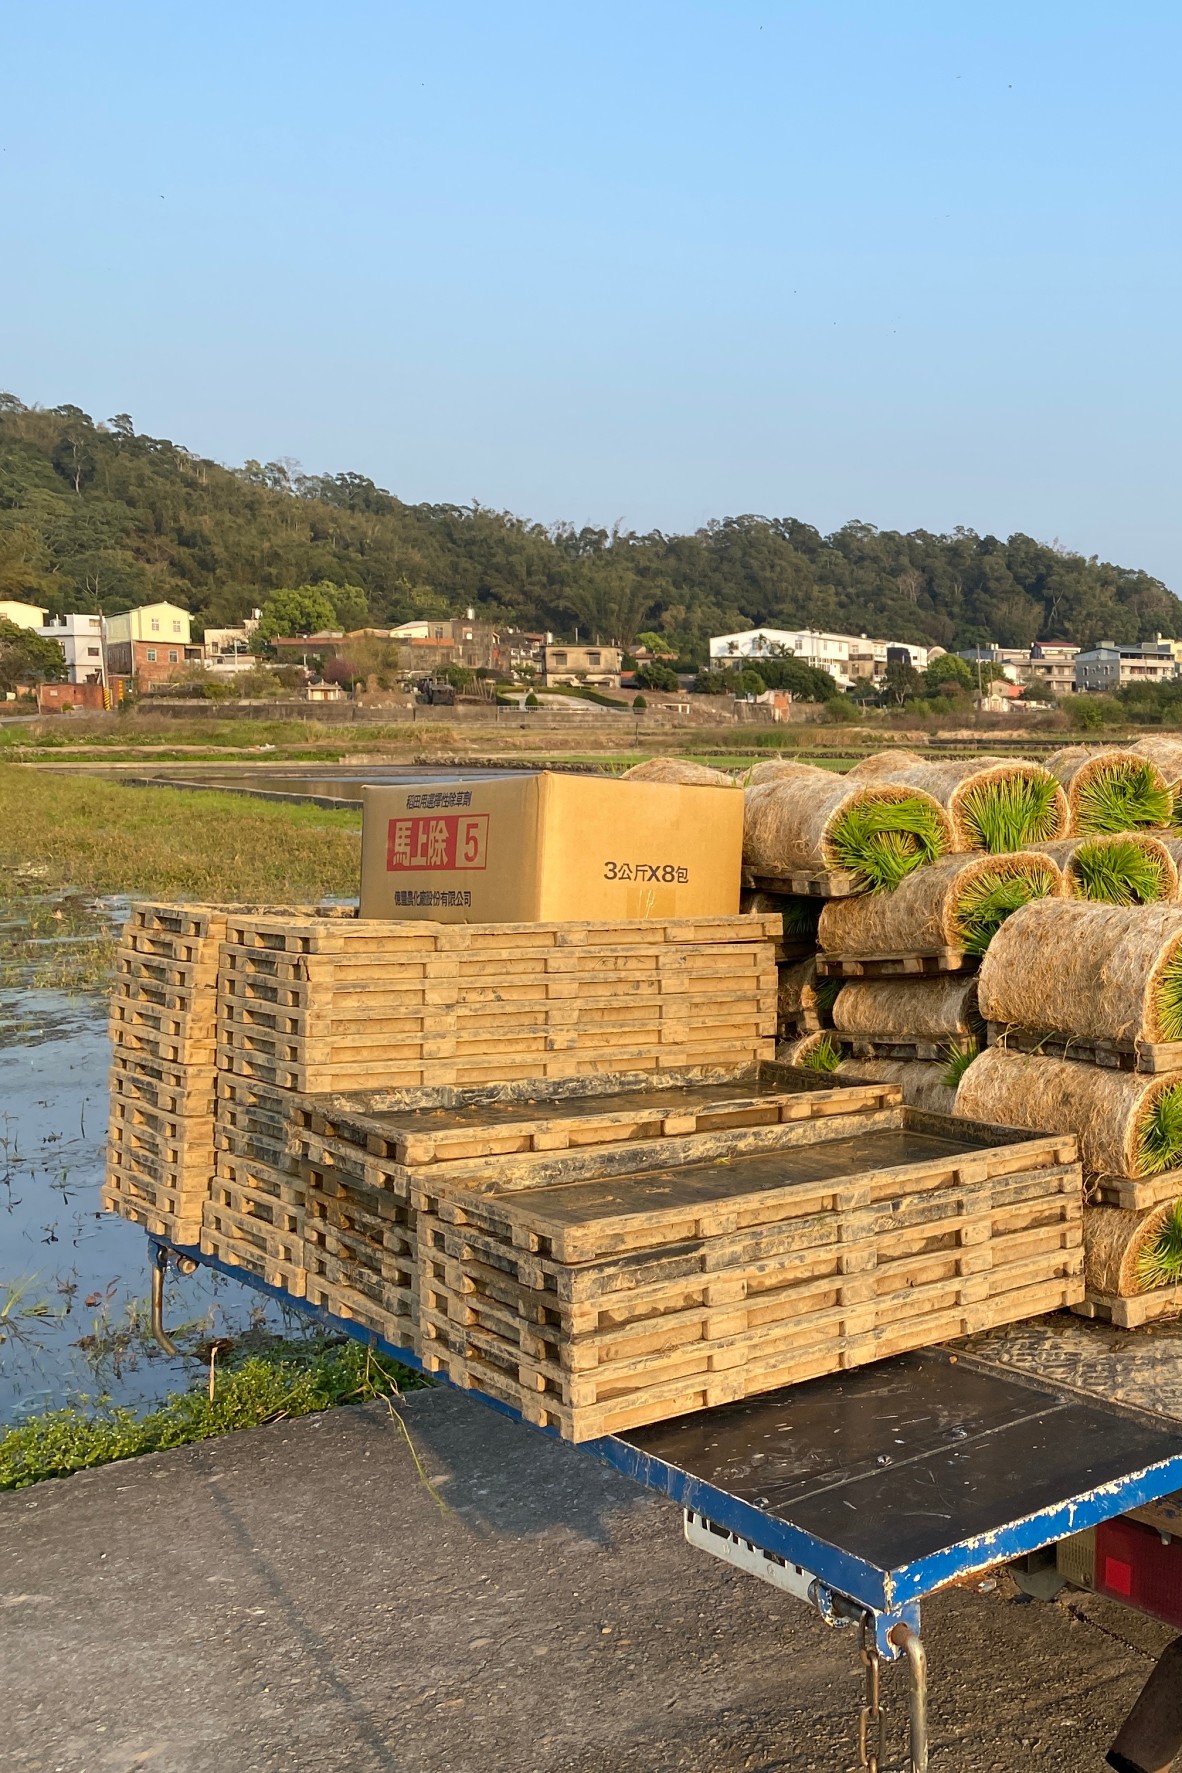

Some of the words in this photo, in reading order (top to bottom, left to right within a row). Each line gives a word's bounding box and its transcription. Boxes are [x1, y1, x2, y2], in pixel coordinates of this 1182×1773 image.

[406, 791, 472, 809] 稻田用選擇性除草劑
[393, 820, 448, 867] 馬上除
[464, 822, 479, 862] 5
